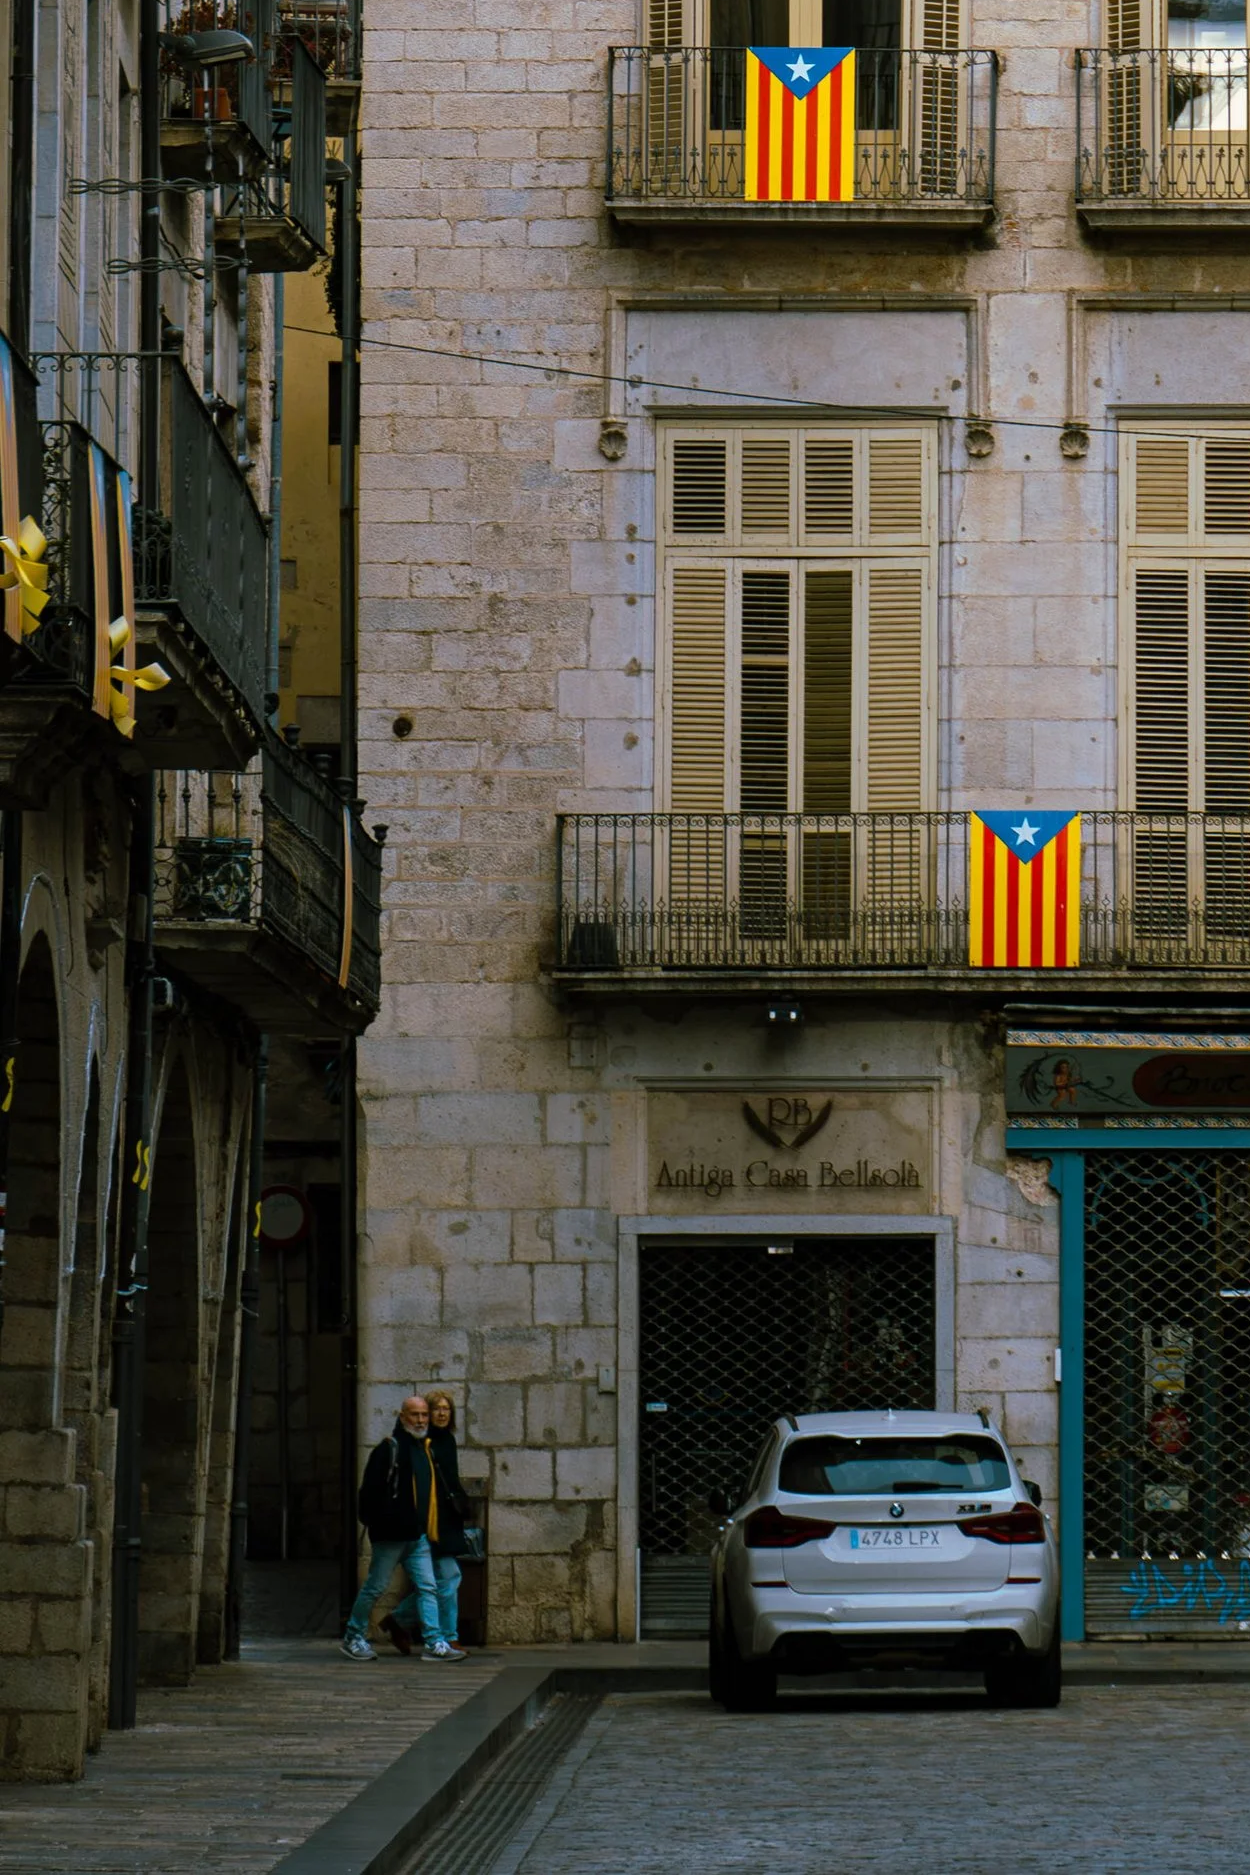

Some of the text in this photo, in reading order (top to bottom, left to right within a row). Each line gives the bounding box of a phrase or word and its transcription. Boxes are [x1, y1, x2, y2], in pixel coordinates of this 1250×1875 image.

[655, 1159, 923, 1197] Antiga Casa Bellsolà
[862, 1529, 940, 1545] 4748 LPX
